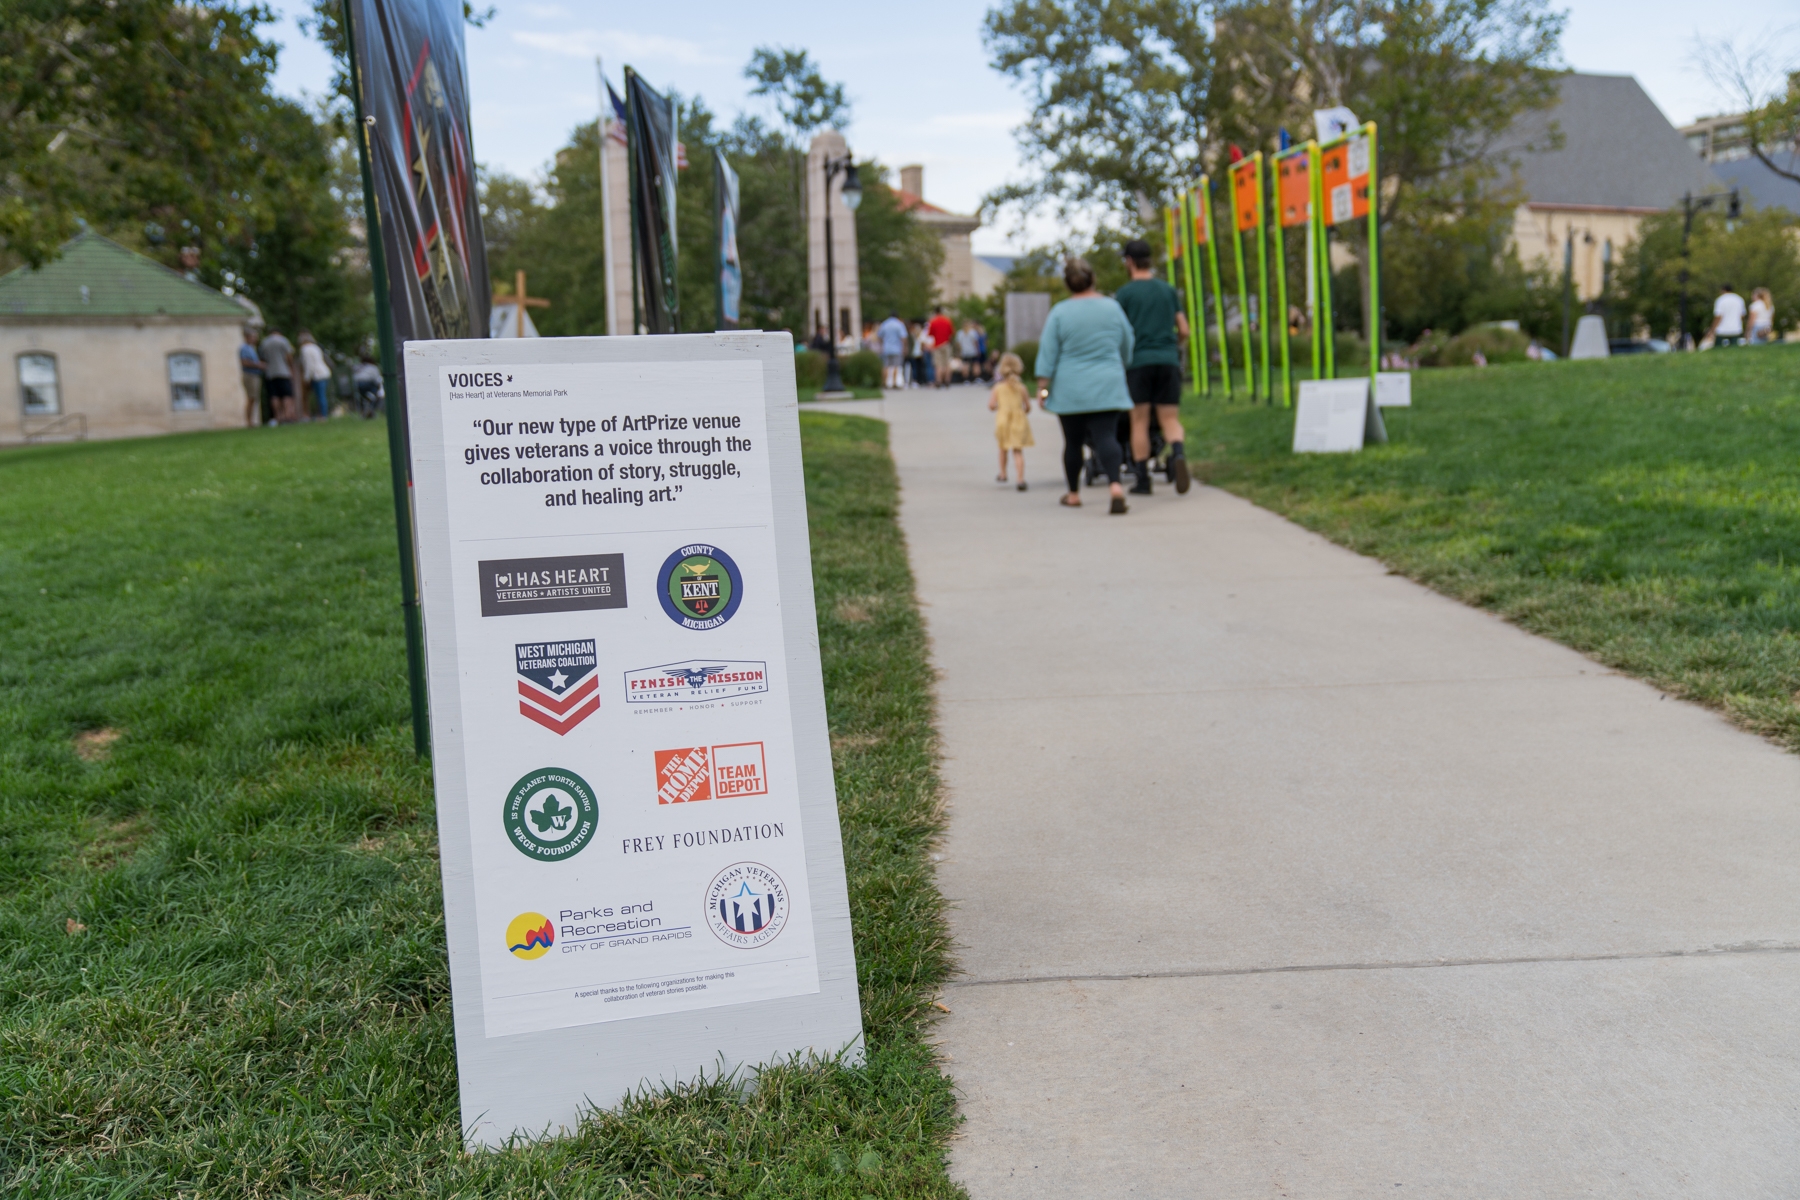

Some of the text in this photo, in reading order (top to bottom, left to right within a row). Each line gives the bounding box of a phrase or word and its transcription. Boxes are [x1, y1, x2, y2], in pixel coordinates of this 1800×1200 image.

[448, 373, 503, 387] VOICES
[450, 392, 464, 400] [Has
[466, 391, 484, 399] Heart]
[473, 414, 740, 437] “Our new type of ArtPrize venue
[464, 435, 751, 464] gives veterans a voice through the
[480, 460, 741, 485] collaboration of story, struggle,
[545, 485, 683, 507] and healing art.”
[681, 545, 714, 556] COUNTY
[517, 568, 609, 586] HAS HEART
[497, 586, 611, 599] VETERANS ARTISTS UNITED
[683, 582, 718, 597] KENT
[682, 615, 725, 629] MICHIGAN
[518, 642, 594, 659] WEST MICHIGAN
[519, 656, 595, 670] VETERANS COALITION
[631, 677, 685, 689] FINISH
[708, 671, 763, 683] MISSION
[632, 692, 679, 700] VETERAN
[634, 707, 673, 715] REMEMBER
[658, 746, 708, 804] HOME
[661, 754, 683, 777] THE
[718, 764, 756, 779] TEAM
[679, 766, 709, 802] DEPOT
[719, 778, 761, 794] DEPOT
[512, 775, 591, 820] IS THE PLANET WORTH SAVING
[551, 815, 566, 827] W
[514, 821, 591, 855] WEGE FOUNDATION
[623, 822, 785, 854] FREY FOUNDATION
[710, 867, 784, 910] MICHIGAN VETERANS
[560, 900, 653, 922] Parks and
[561, 917, 661, 937] Recreation
[715, 913, 783, 944] AFFAIRS AGENCY
[562, 944, 586, 953] CITY
[609, 936, 648, 947] GRAND
[653, 931, 692, 942] RAPIDS
[580, 989, 599, 998] special
[600, 987, 618, 995] thanks
[636, 982, 659, 990] following
[661, 978, 695, 987] organizations
[705, 973, 724, 981] making
[604, 993, 638, 1003] collaboration
[645, 989, 665, 997] veteran
[685, 984, 708, 992] possible.
